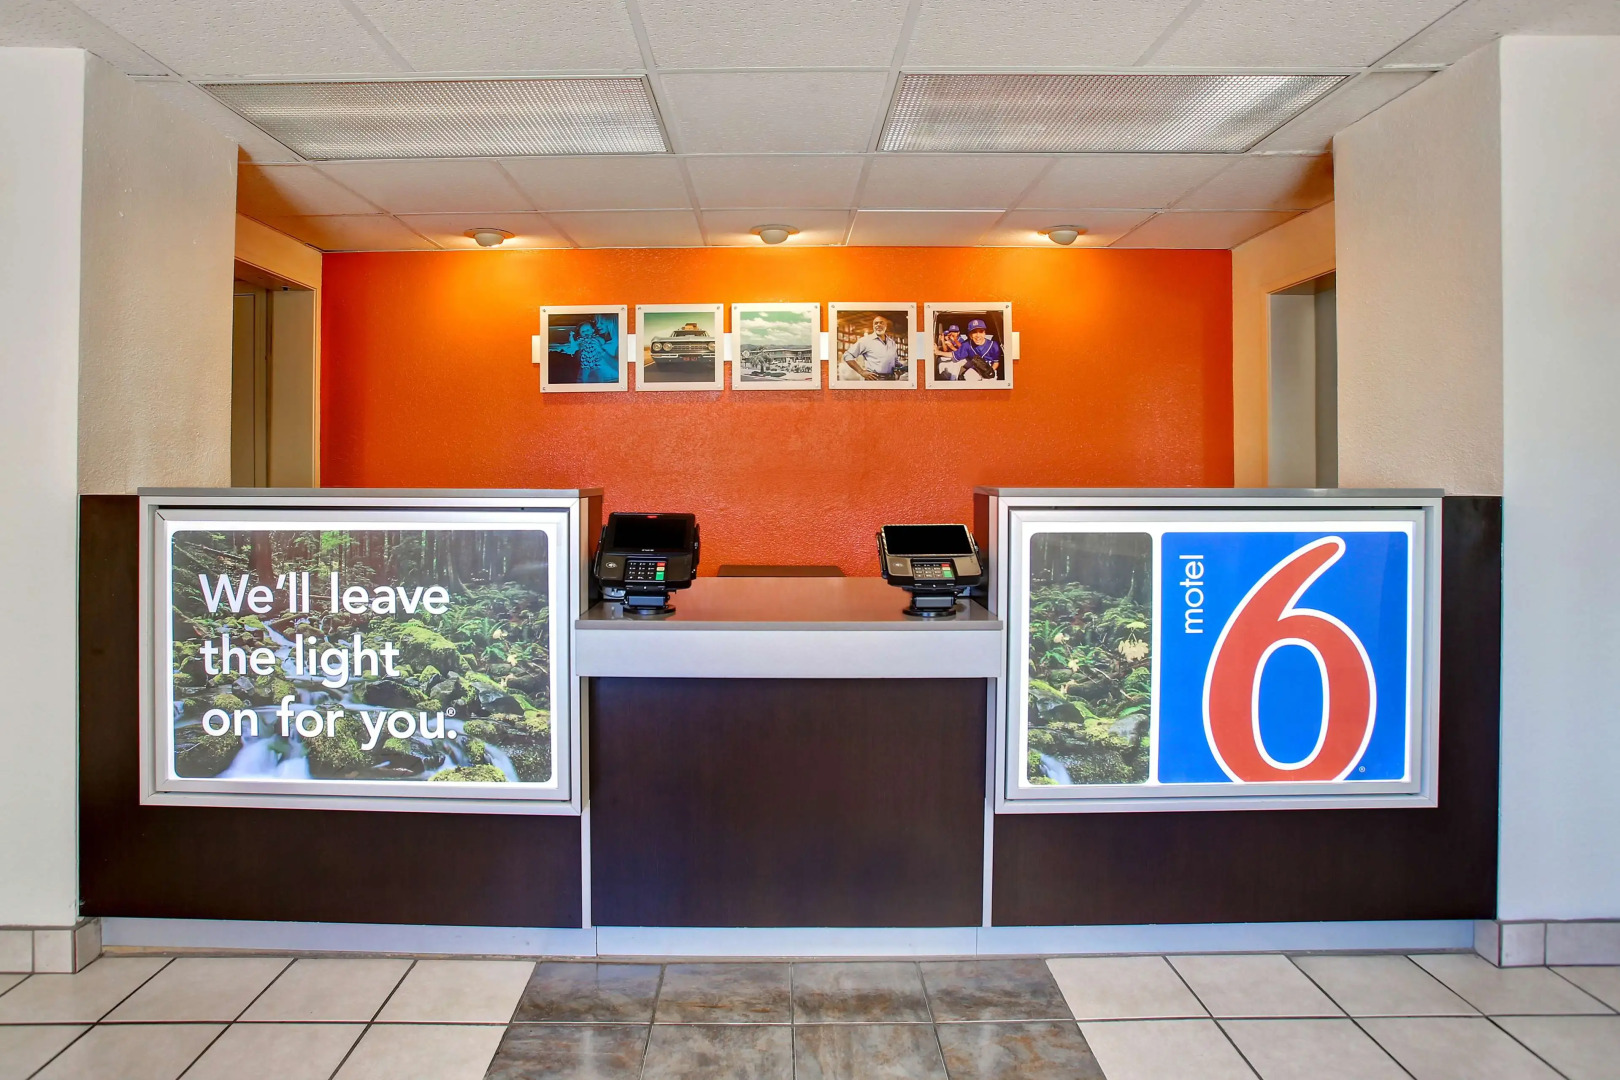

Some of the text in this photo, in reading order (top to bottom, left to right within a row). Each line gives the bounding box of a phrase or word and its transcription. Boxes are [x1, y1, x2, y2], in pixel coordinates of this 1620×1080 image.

[198, 571, 450, 615] We'll leave
[200, 633, 400, 689] the light
[1179, 535, 1378, 783] motel 6
[201, 707, 259, 737] on
[276, 694, 345, 738] for
